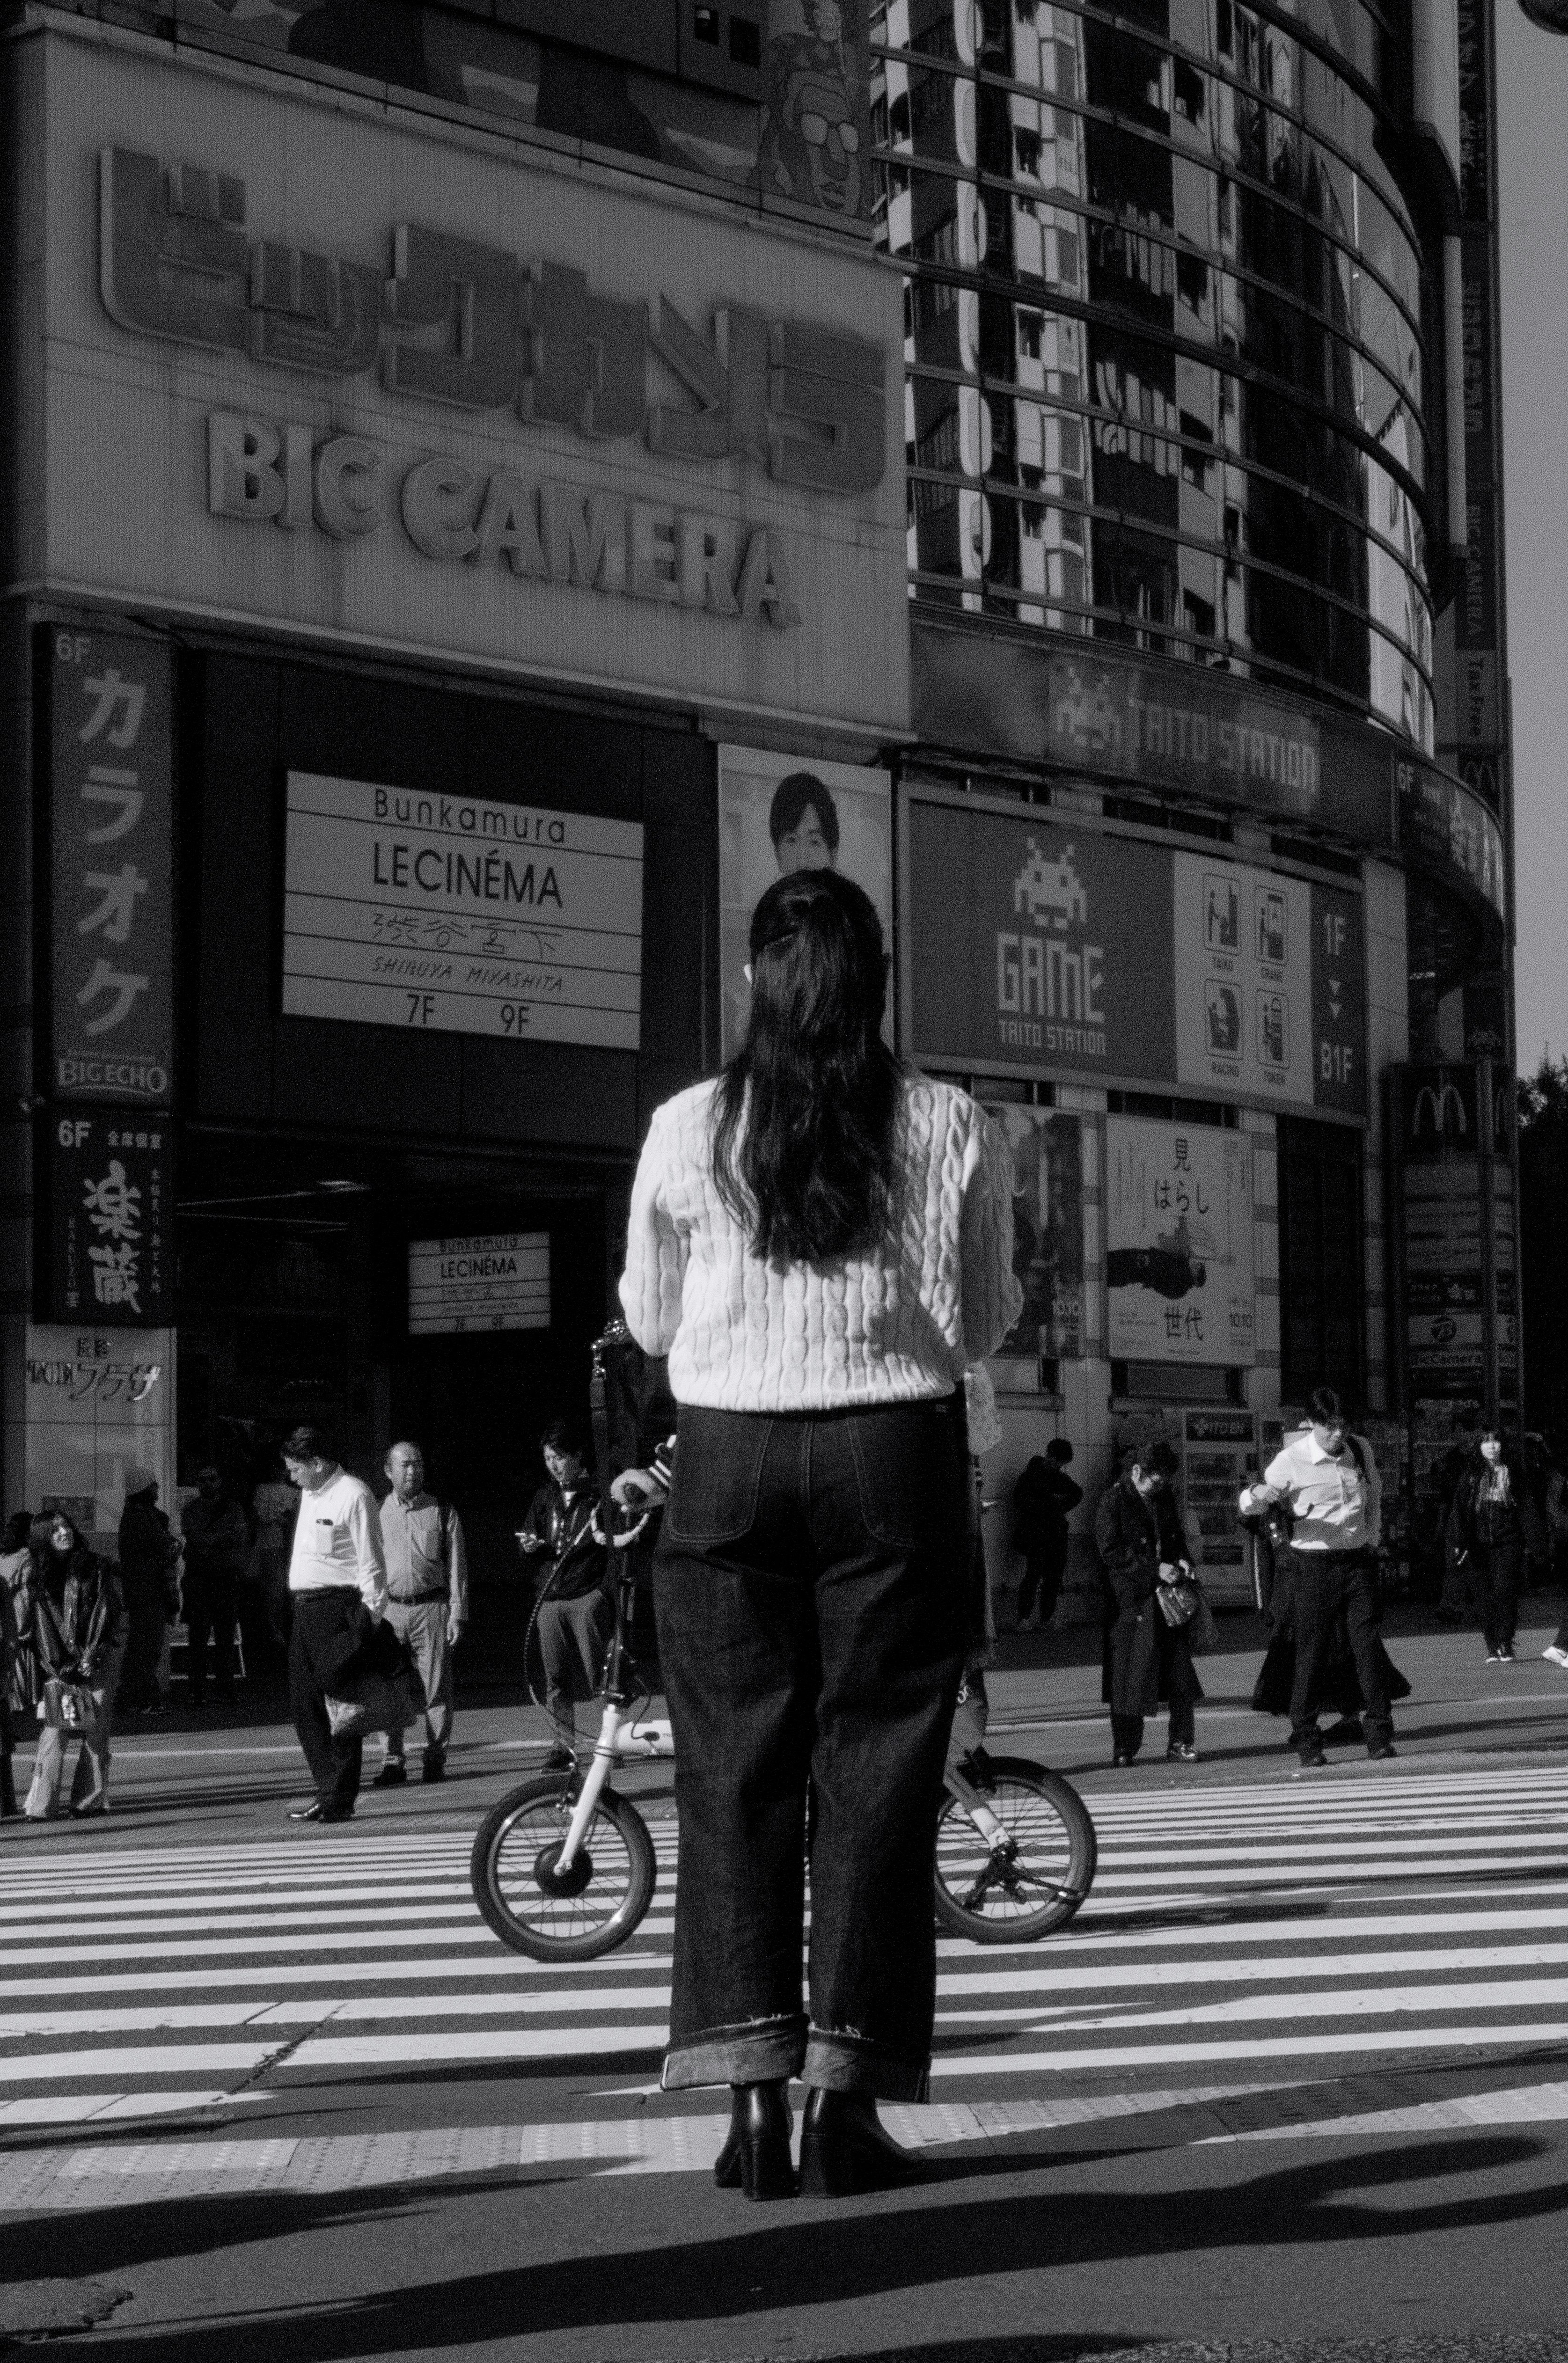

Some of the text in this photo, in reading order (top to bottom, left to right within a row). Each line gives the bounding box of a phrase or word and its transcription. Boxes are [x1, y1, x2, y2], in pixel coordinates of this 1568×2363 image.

[208, 407, 801, 628] BIC CAMERA
[1467, 544, 1483, 635] CAMERA
[56, 633, 92, 663] 6F
[1469, 658, 1484, 736] Tax Free
[1128, 699, 1317, 794] TAITO STATION
[374, 788, 565, 844] Bunkamura
[76, 668, 150, 1037] カラオケ
[1324, 913, 1346, 957] 1F
[372, 956, 564, 992] SHIBUYA MIYASHITA
[997, 932, 1105, 1024] GAME
[1212, 956, 1233, 972] TAIKO
[1260, 967, 1283, 983] CRANE
[407, 994, 530, 1035] 7F 9F
[998, 1018, 1106, 1056] TAITO STATION
[57, 1057, 168, 1094] BIG ECHO
[1211, 1061, 1239, 1078] RACING
[1264, 1070, 1285, 1085] TOKEN
[1321, 1042, 1353, 1083] B1F
[59, 1120, 92, 1149] 6F
[1173, 1138, 1191, 1171] 見
[1154, 1179, 1210, 1214] はらし
[440, 1237, 518, 1252] Bunkamura
[1163, 1306, 1204, 1341] 世代
